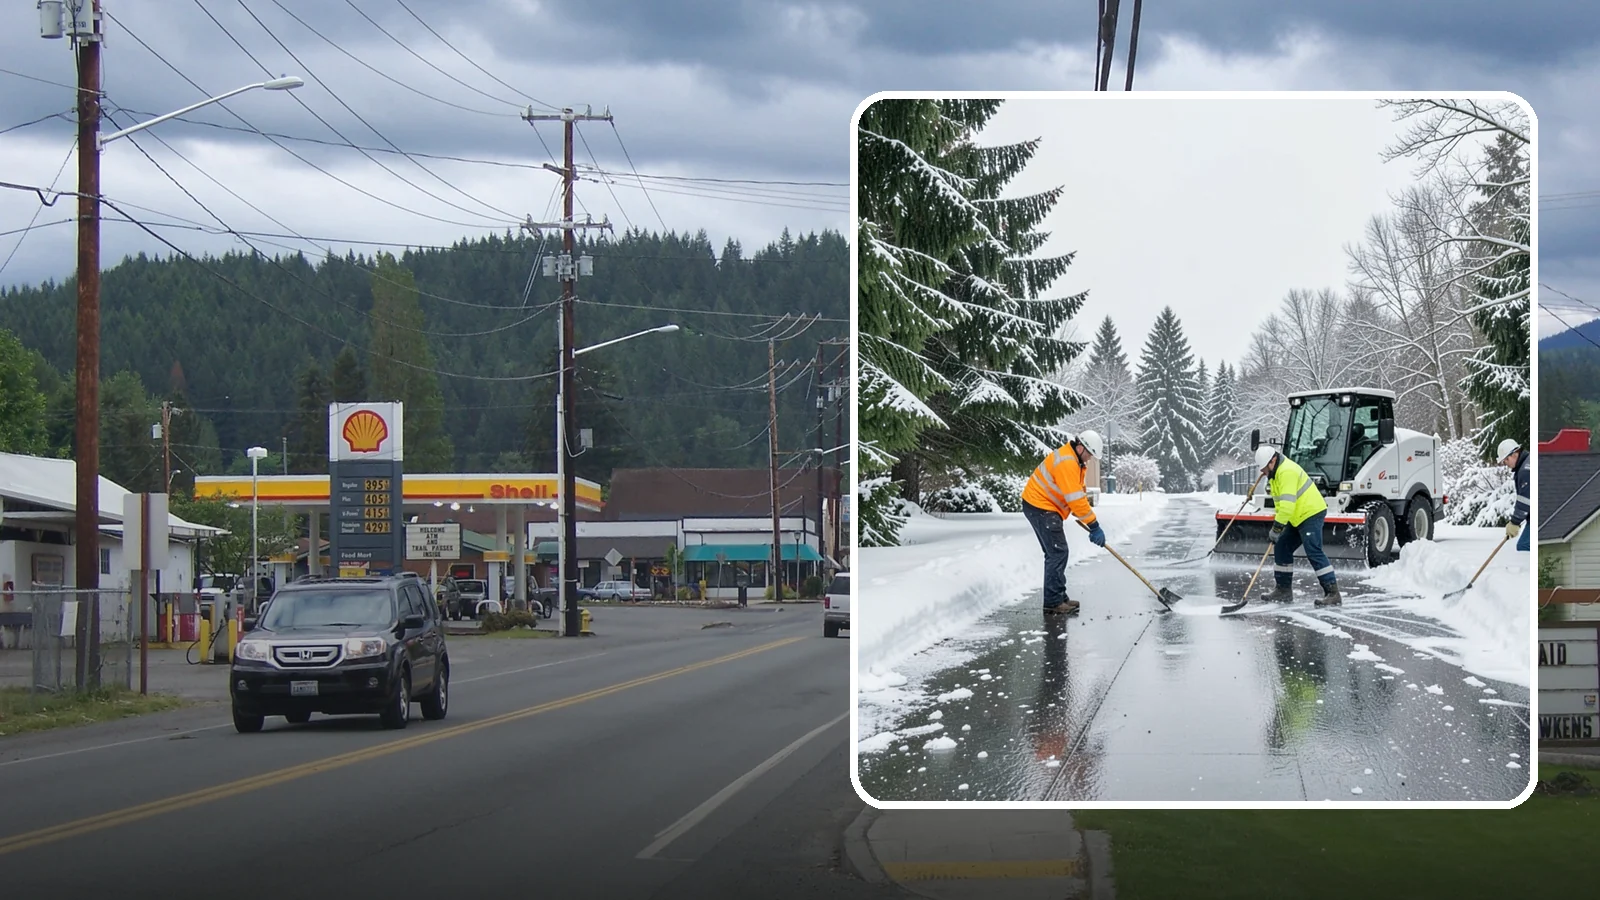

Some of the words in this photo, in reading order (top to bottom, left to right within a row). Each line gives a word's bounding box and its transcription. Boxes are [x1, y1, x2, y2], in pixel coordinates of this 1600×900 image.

[365, 480, 384, 490] 395
[490, 484, 547, 499] Shell
[365, 494, 384, 504] 405
[365, 508, 384, 518] 415
[365, 522, 384, 533] 429
